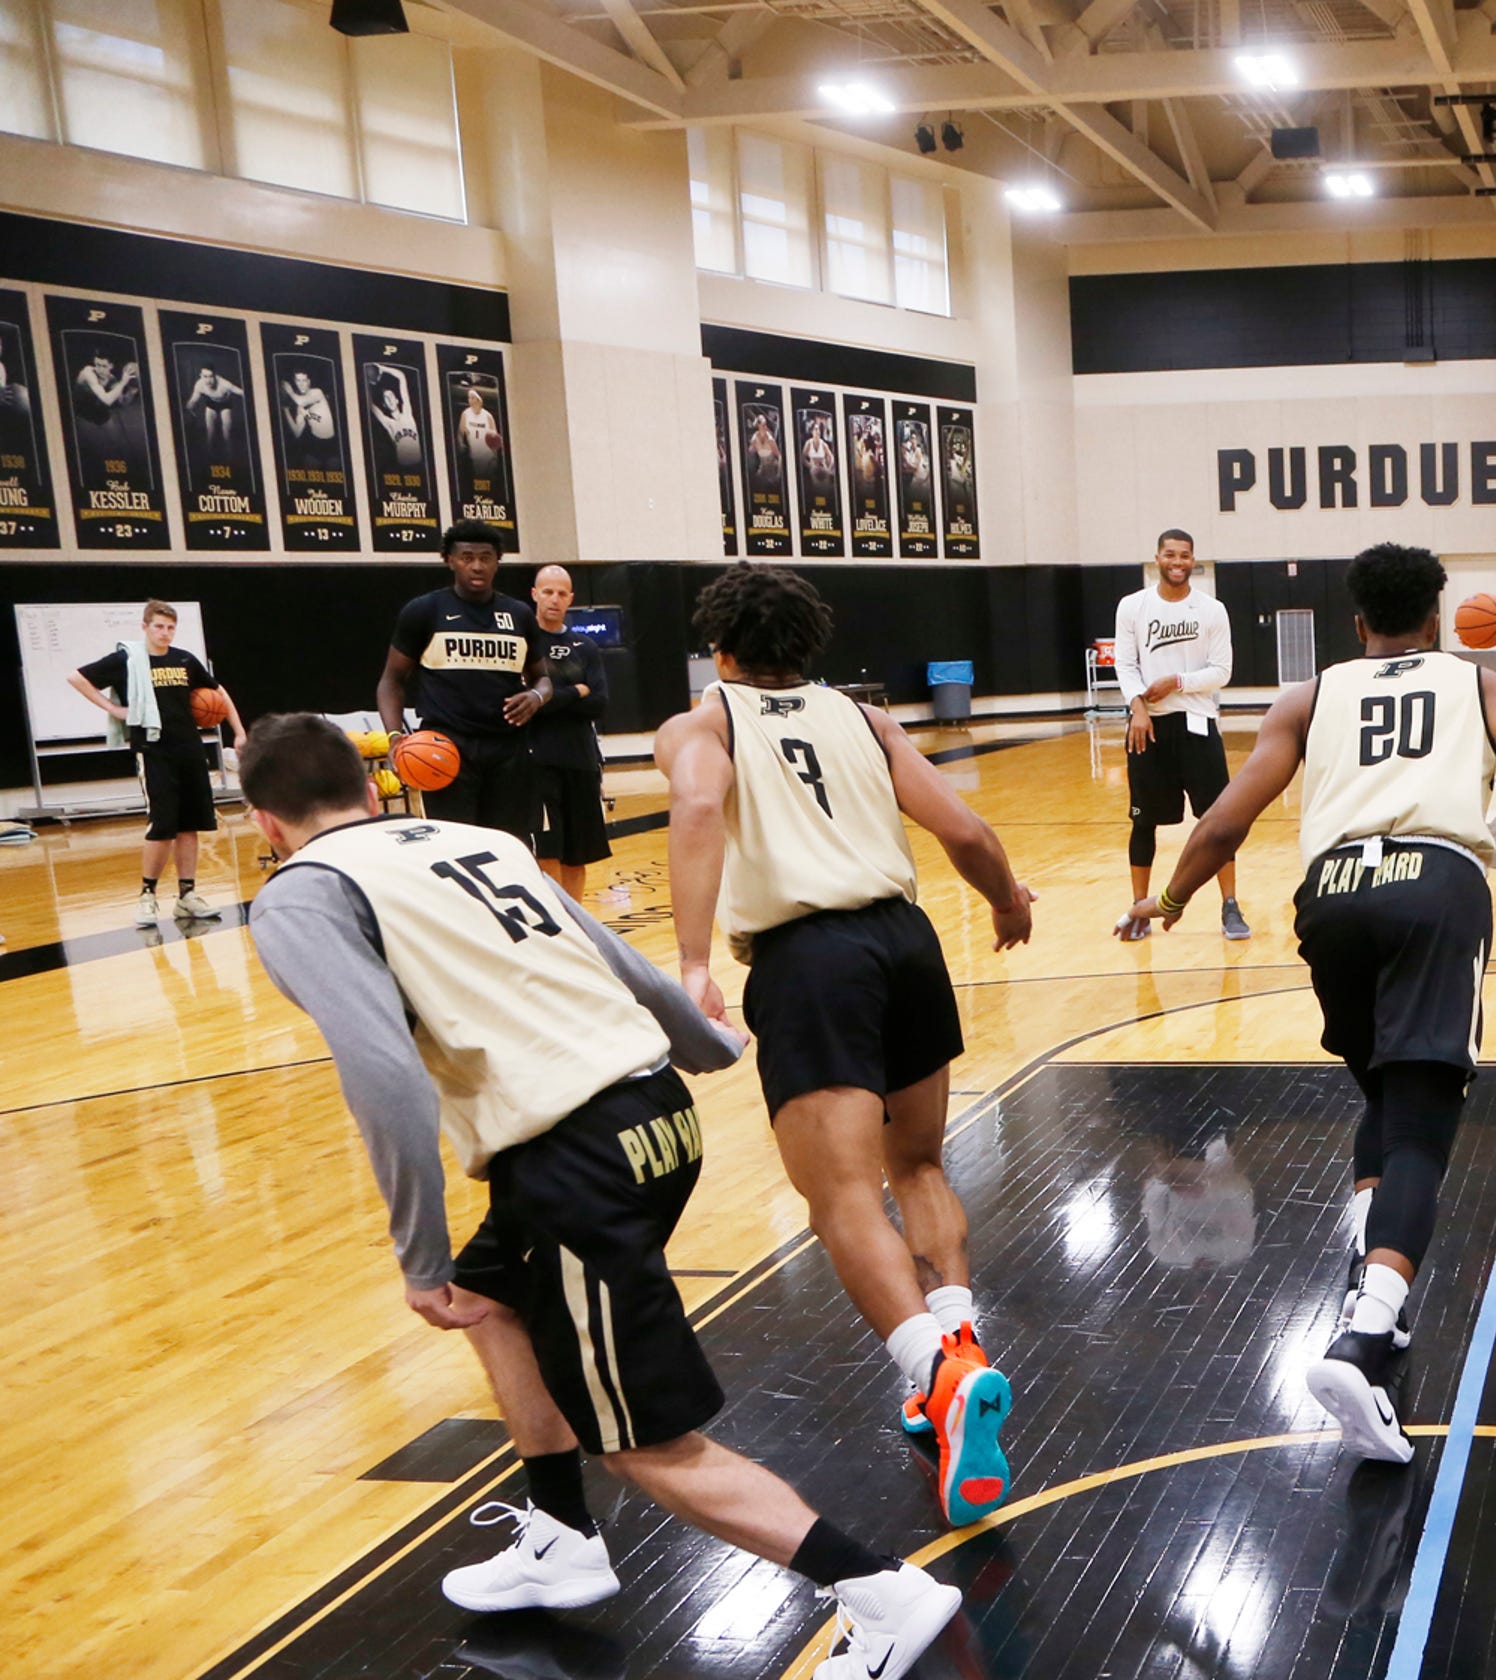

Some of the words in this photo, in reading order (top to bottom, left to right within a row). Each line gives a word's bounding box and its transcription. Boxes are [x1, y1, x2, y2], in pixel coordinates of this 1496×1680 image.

[0, 487, 28, 506] UNG
[89, 490, 149, 509] KESSLER
[198, 495, 250, 512] COTTOM
[294, 498, 343, 516] WOODEN
[382, 501, 426, 518] MURPHY
[463, 504, 507, 520] GEARLDS
[115, 524, 132, 537] 23
[223, 527, 231, 539] 7
[317, 528, 329, 540] 13
[401, 530, 414, 541] 27
[494, 612, 514, 630] 50
[1145, 619, 1199, 648] Purdue
[445, 638, 517, 660] PURDUE
[151, 667, 189, 680] URDUE
[1359, 691, 1436, 767] 20
[1317, 857, 1364, 898] PLAY
[1371, 851, 1423, 889] HARD
[430, 851, 562, 943] 15
[617, 1116, 679, 1184] PLAY
